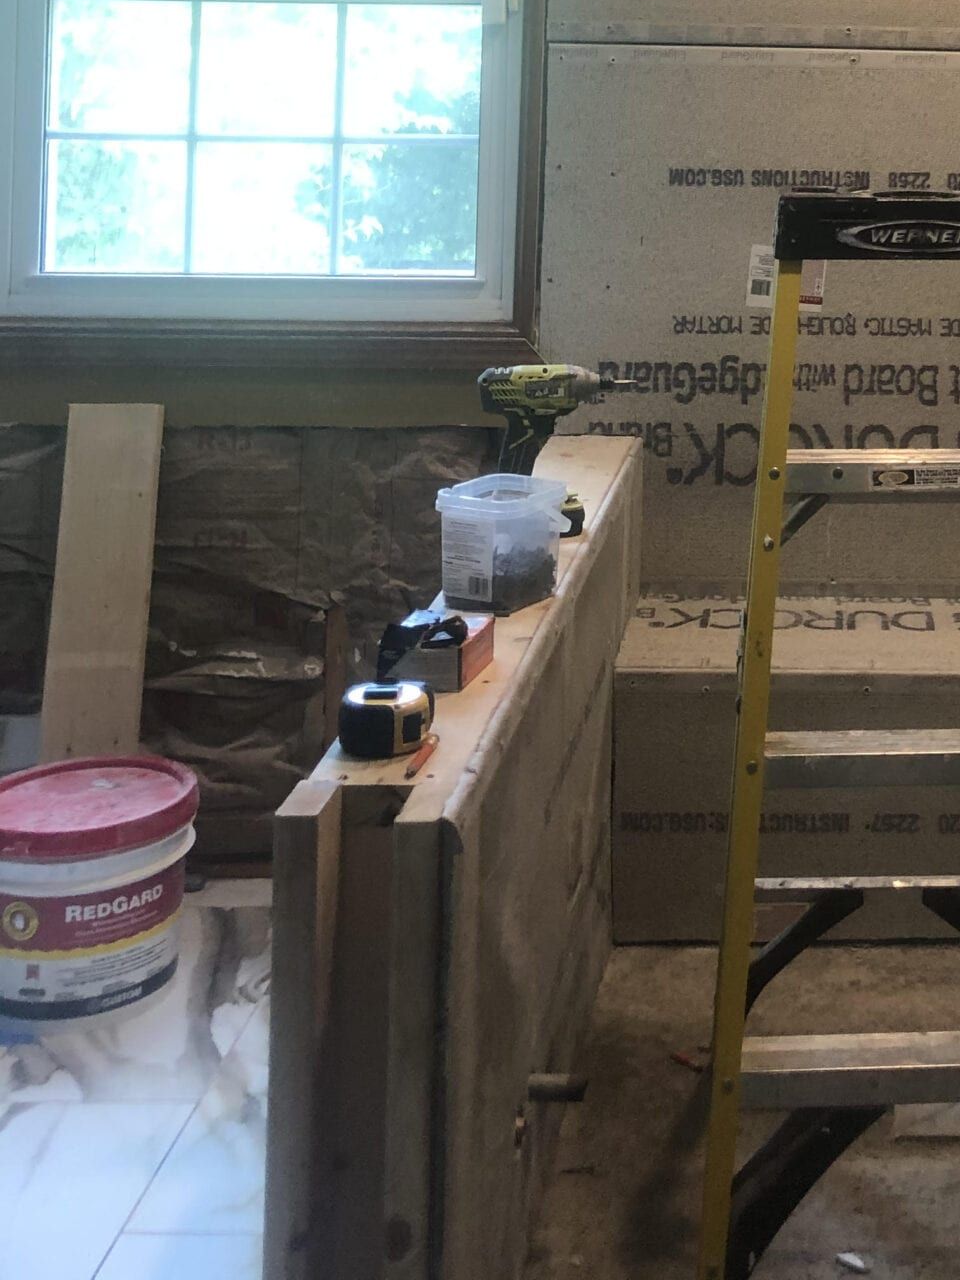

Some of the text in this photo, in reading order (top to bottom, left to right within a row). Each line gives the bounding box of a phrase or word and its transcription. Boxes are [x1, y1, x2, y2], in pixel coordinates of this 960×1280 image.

[668, 168, 744, 187] USG.COM
[672, 315, 742, 334] MORTAR
[750, 316, 772, 335] DE
[597, 355, 767, 405] dgeGuard
[843, 364, 940, 406] Board
